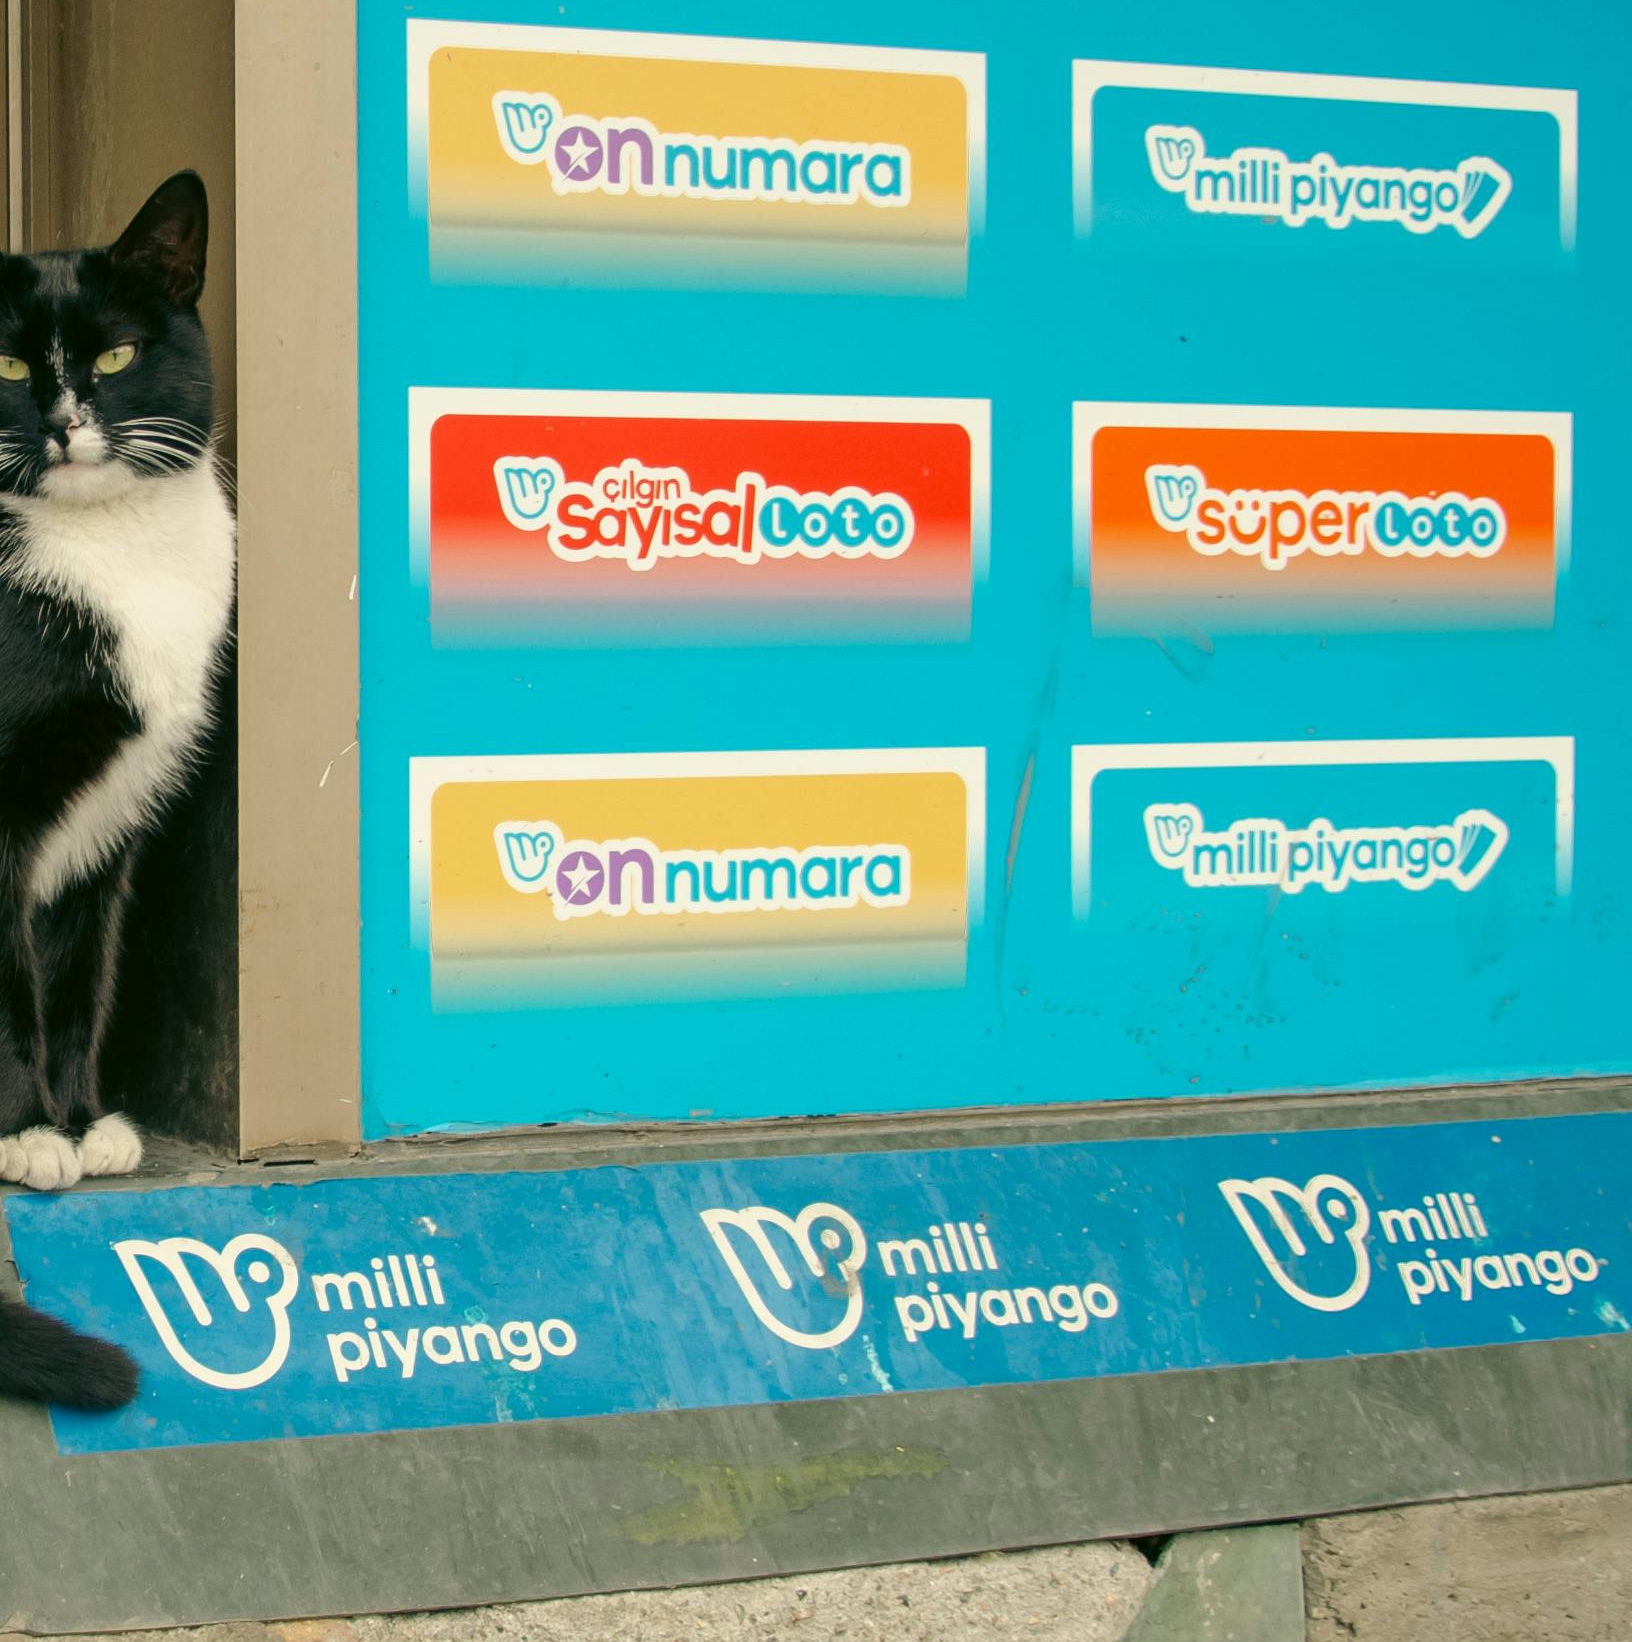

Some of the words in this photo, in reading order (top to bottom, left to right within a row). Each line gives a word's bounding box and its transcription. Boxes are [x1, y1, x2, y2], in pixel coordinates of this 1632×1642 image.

[555, 125, 653, 186] on
[664, 143, 902, 197] numara
[1193, 159, 1280, 206] milli
[1290, 164, 1460, 221] piyango
[602, 469, 682, 509] çılgın
[556, 847, 655, 908] on
[666, 854, 901, 904] numara
[1193, 829, 1278, 875] milli
[1287, 829, 1457, 882] piyango
[1377, 1191, 1488, 1244] milli
[876, 1221, 999, 1276] milli
[1396, 1247, 1599, 1306] piyango
[311, 1254, 446, 1313] milli
[893, 1280, 1119, 1344] piyango
[326, 1316, 577, 1384] piyango
